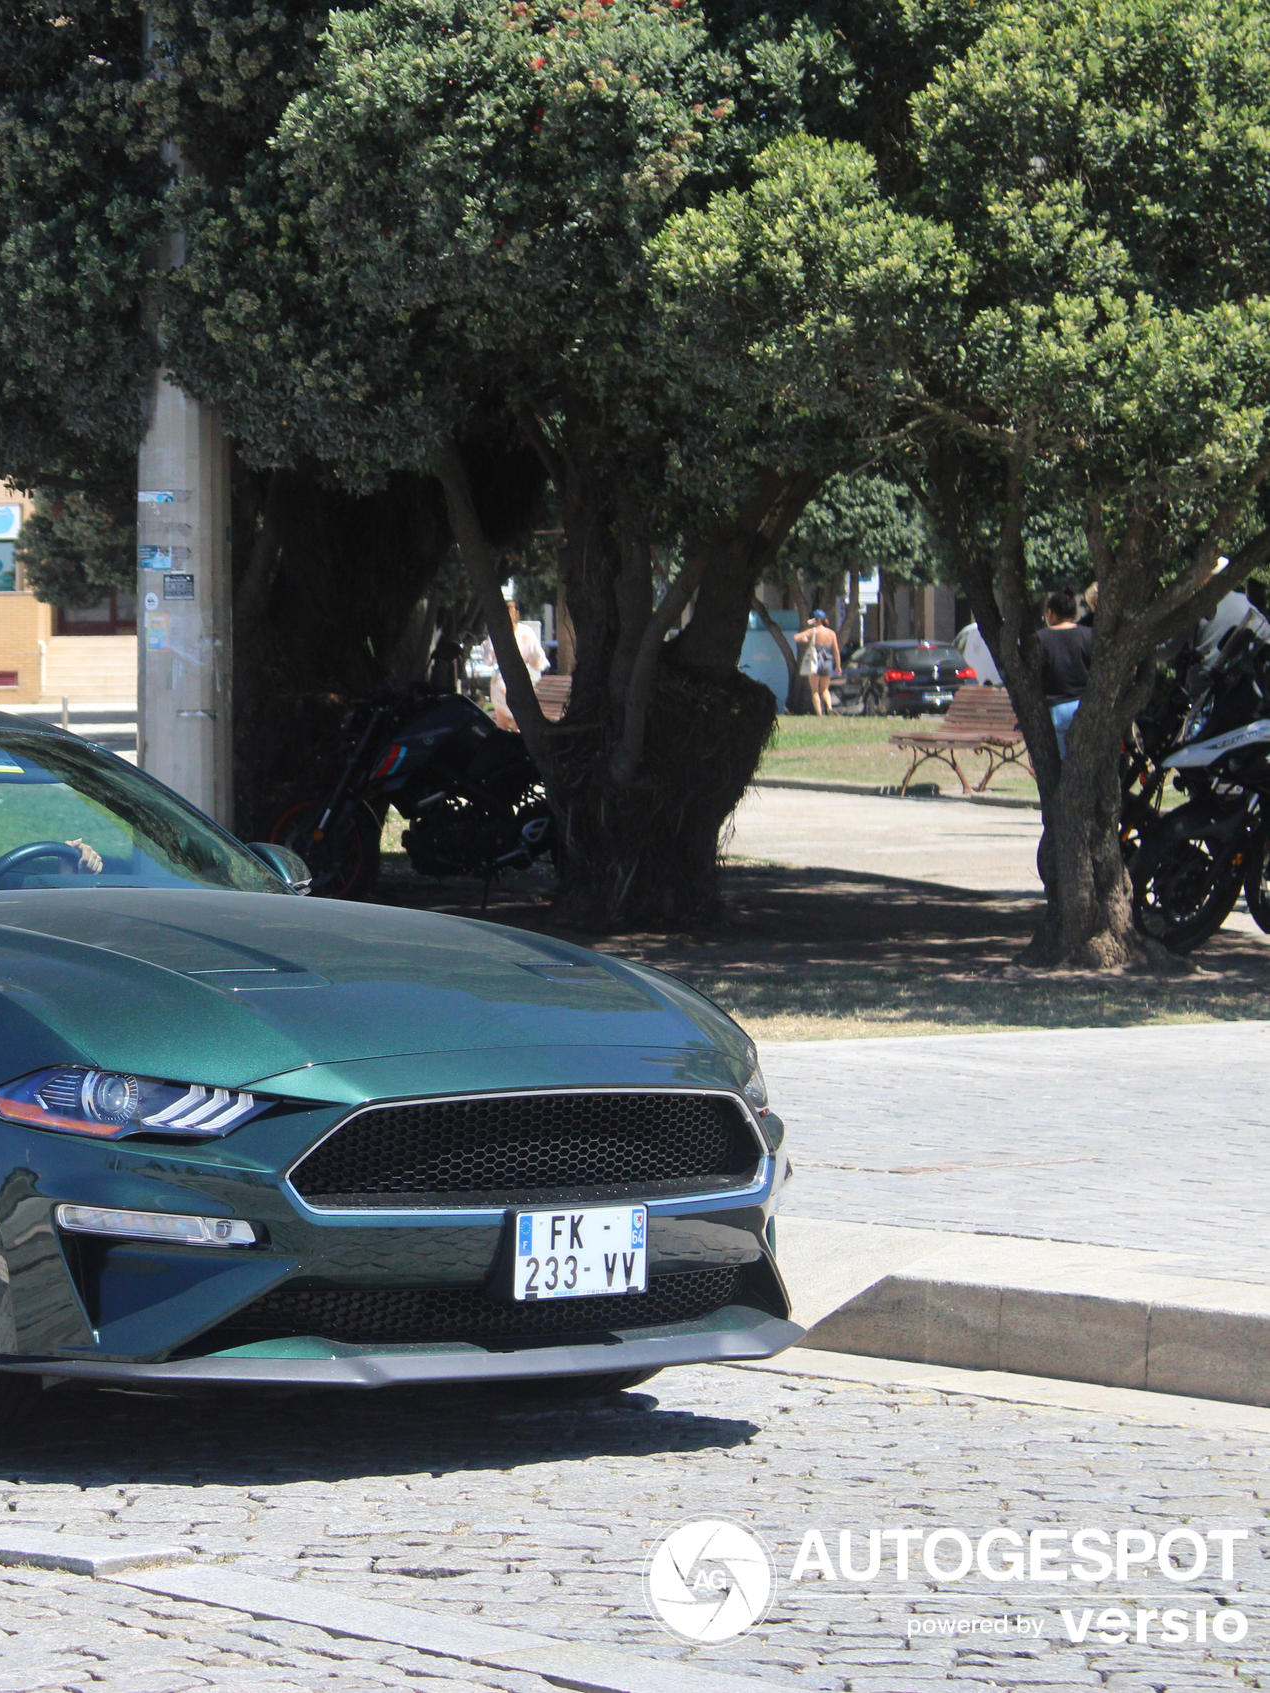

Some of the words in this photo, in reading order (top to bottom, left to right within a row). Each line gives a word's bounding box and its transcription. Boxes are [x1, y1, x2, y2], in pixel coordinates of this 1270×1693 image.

[522, 1241, 528, 1250] F
[550, 1214, 585, 1251] FK
[631, 1229, 644, 1245] 64
[603, 1251, 636, 1287] VV
